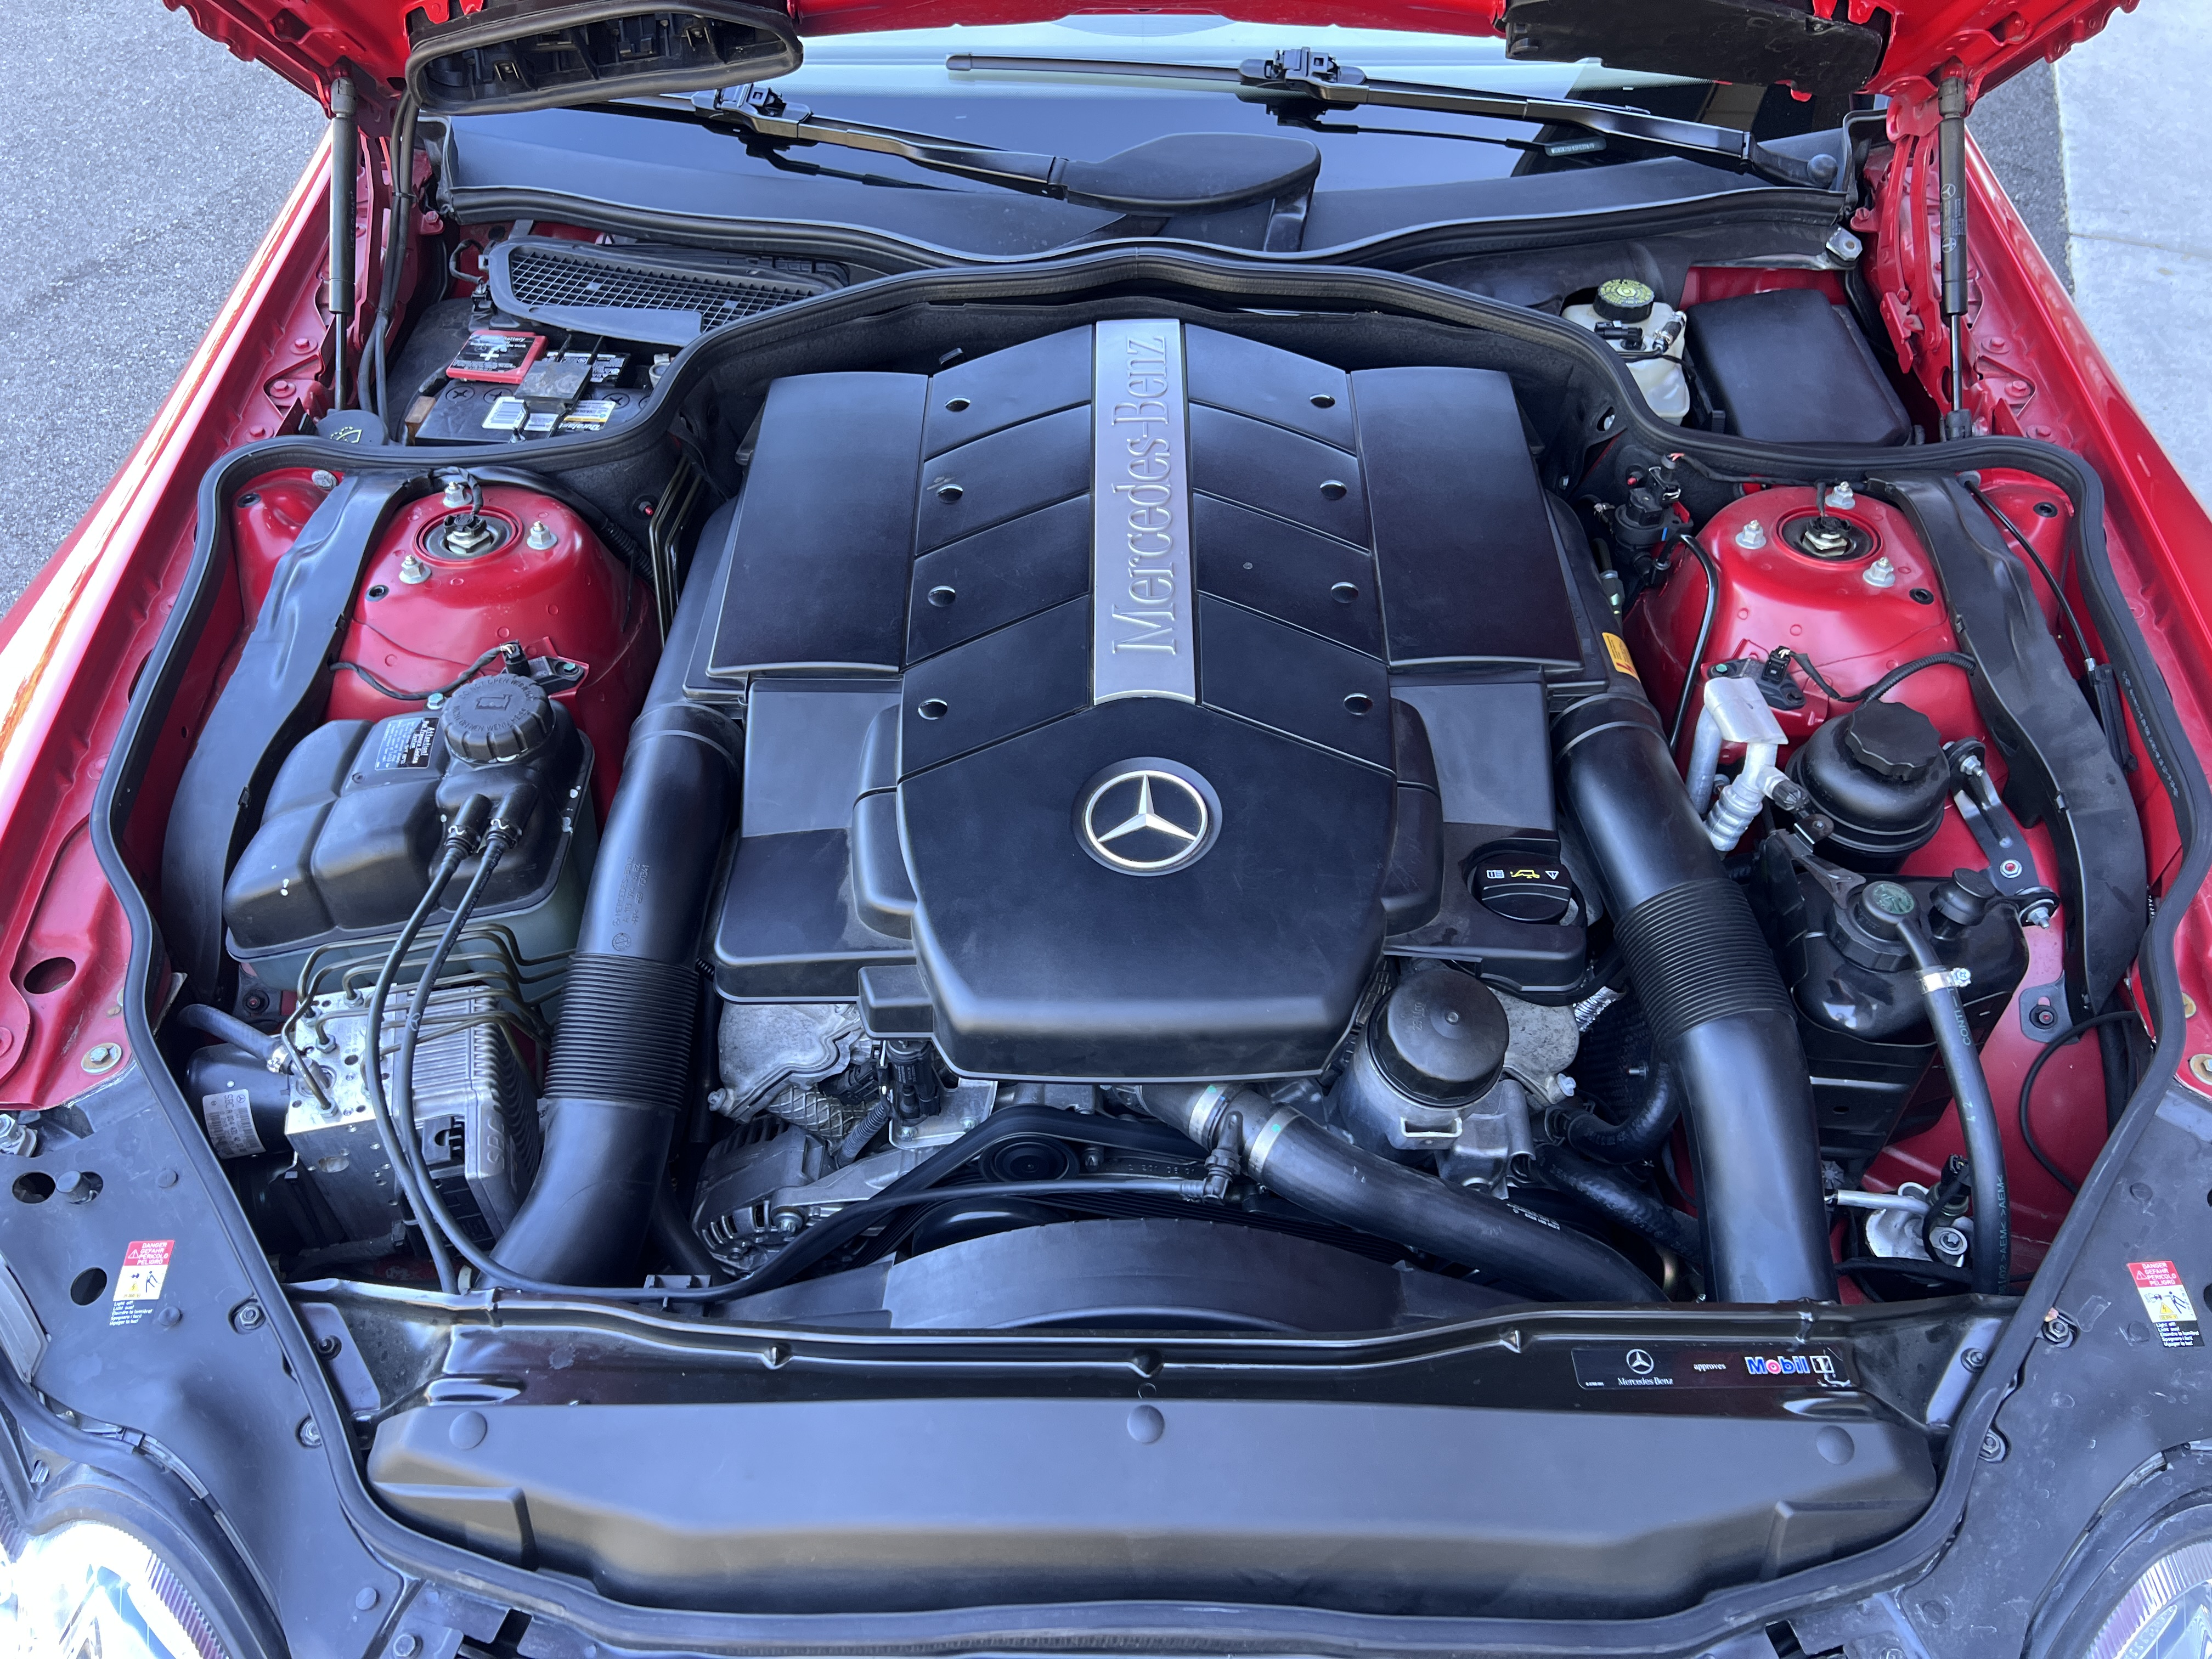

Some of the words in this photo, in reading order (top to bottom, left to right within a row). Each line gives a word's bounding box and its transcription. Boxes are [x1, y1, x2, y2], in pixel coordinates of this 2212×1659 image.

[1111, 336, 1177, 655] Mercedes-Benz
[420, 726, 435, 756] Attention!
[487, 721, 511, 731] WENN
[615, 856, 635, 916] MERCEDES-BENZ
[1954, 1009, 1971, 1046] CONTI
[224, 1094, 234, 1109] SBC
[487, 1117, 505, 1170] SBC
[1996, 1174, 2006, 1217] >AEM<
[1693, 1363, 1726, 1372] approves
[1744, 1356, 1810, 1375] Mobil
[1617, 1377, 1654, 1386] Mercedes
[1653, 1376, 1674, 1386] Benz
